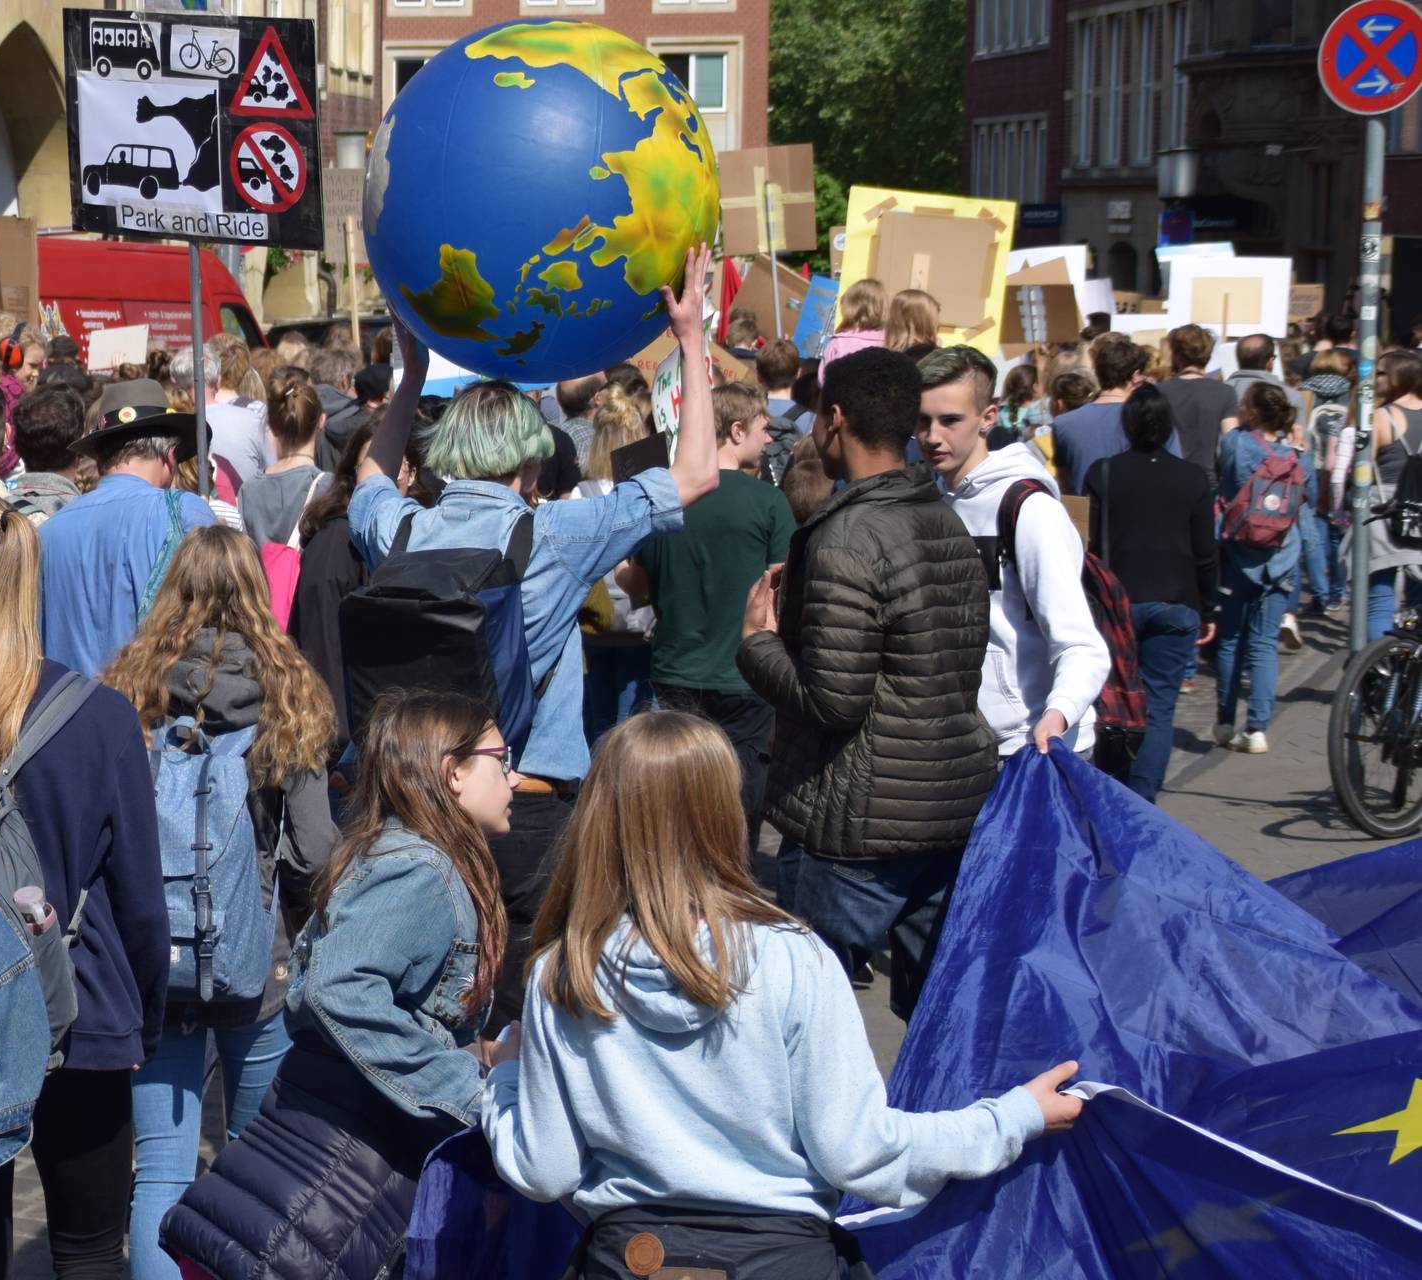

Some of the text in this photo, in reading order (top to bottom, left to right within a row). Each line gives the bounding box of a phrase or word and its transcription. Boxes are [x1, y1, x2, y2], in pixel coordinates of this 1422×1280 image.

[121, 204, 265, 238] Park and Ride
